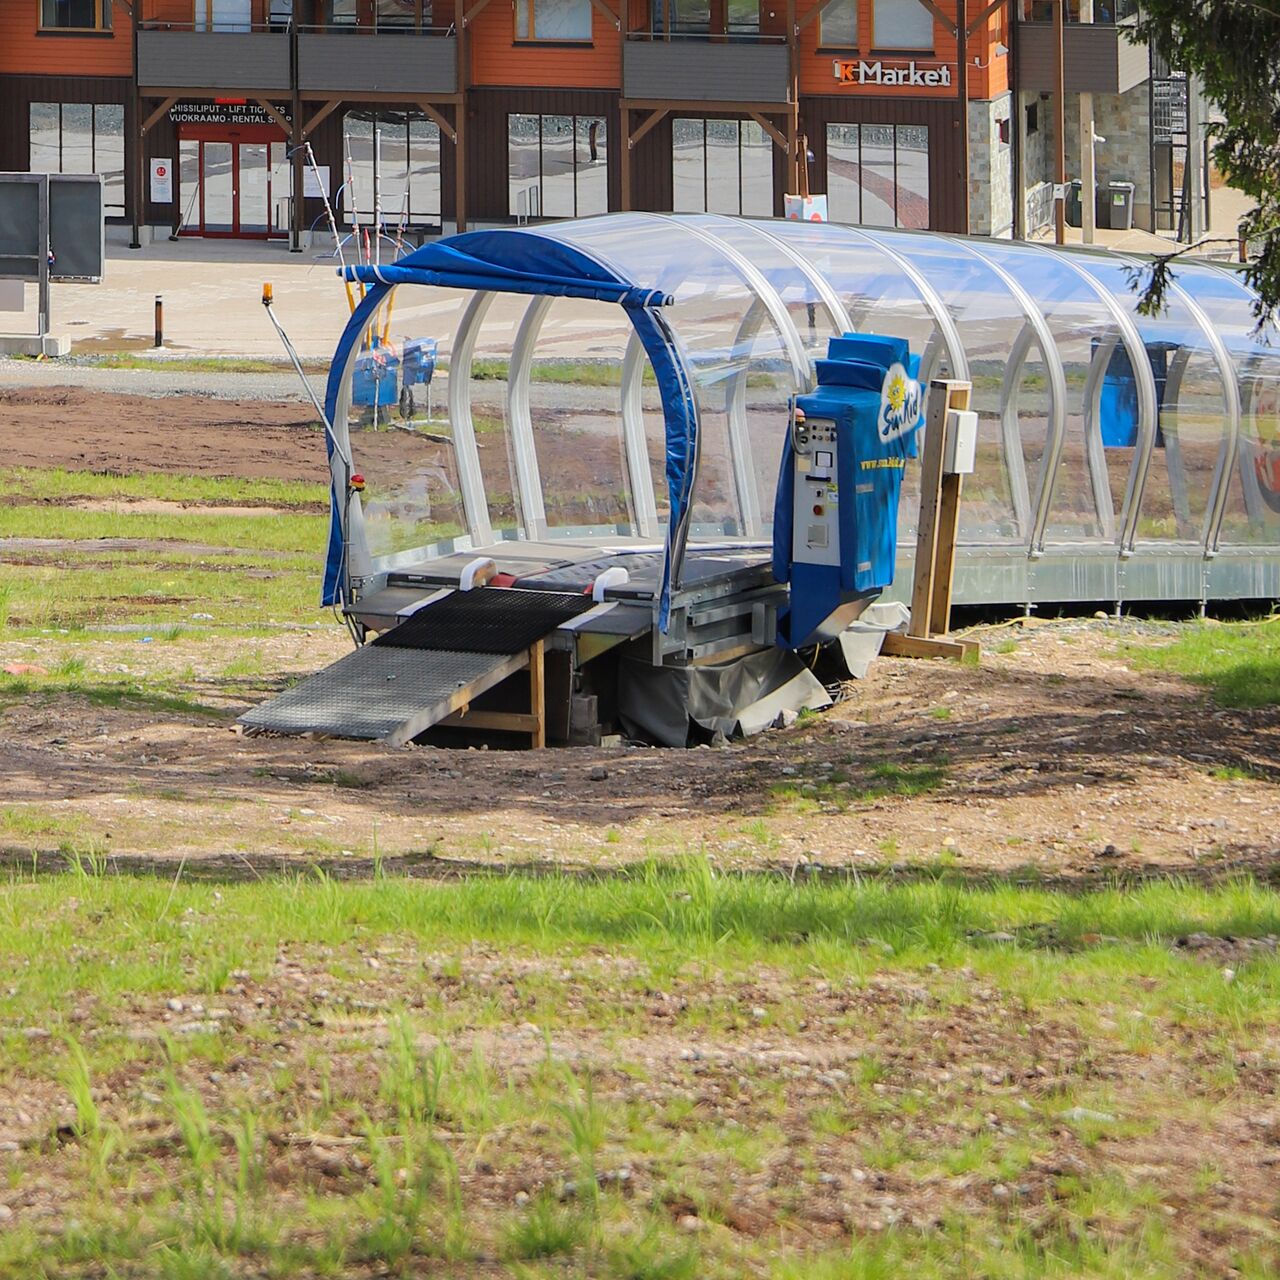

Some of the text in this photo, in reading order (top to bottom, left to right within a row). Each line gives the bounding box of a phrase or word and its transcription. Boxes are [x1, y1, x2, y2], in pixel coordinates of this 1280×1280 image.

[229, 105, 247, 114] LIFT
[170, 113, 226, 123] VUOKRAAMO
[232, 115, 266, 124] RENTAL
